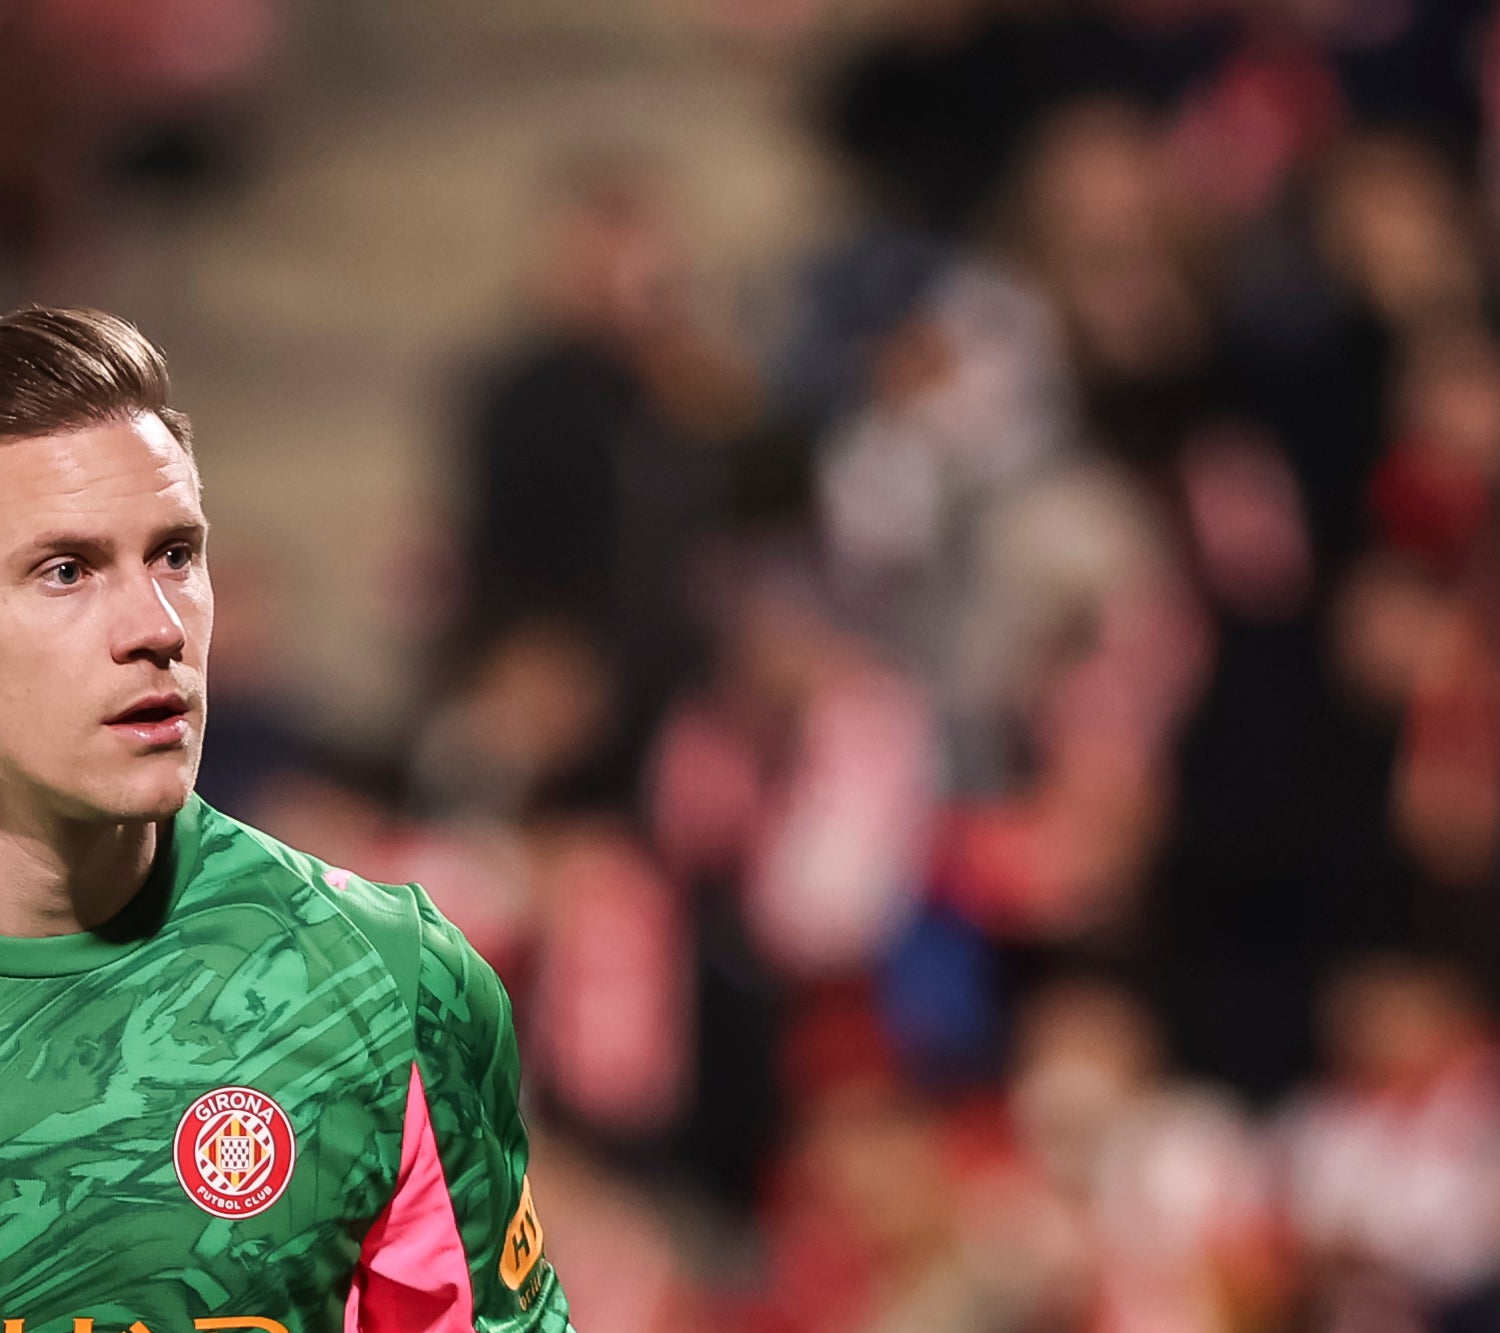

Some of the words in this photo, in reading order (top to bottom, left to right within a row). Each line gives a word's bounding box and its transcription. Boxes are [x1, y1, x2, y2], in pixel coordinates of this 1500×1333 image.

[194, 1091, 274, 1125] GIRONA
[197, 1185, 242, 1210] FUTBOL
[245, 1185, 274, 1208] CLUB
